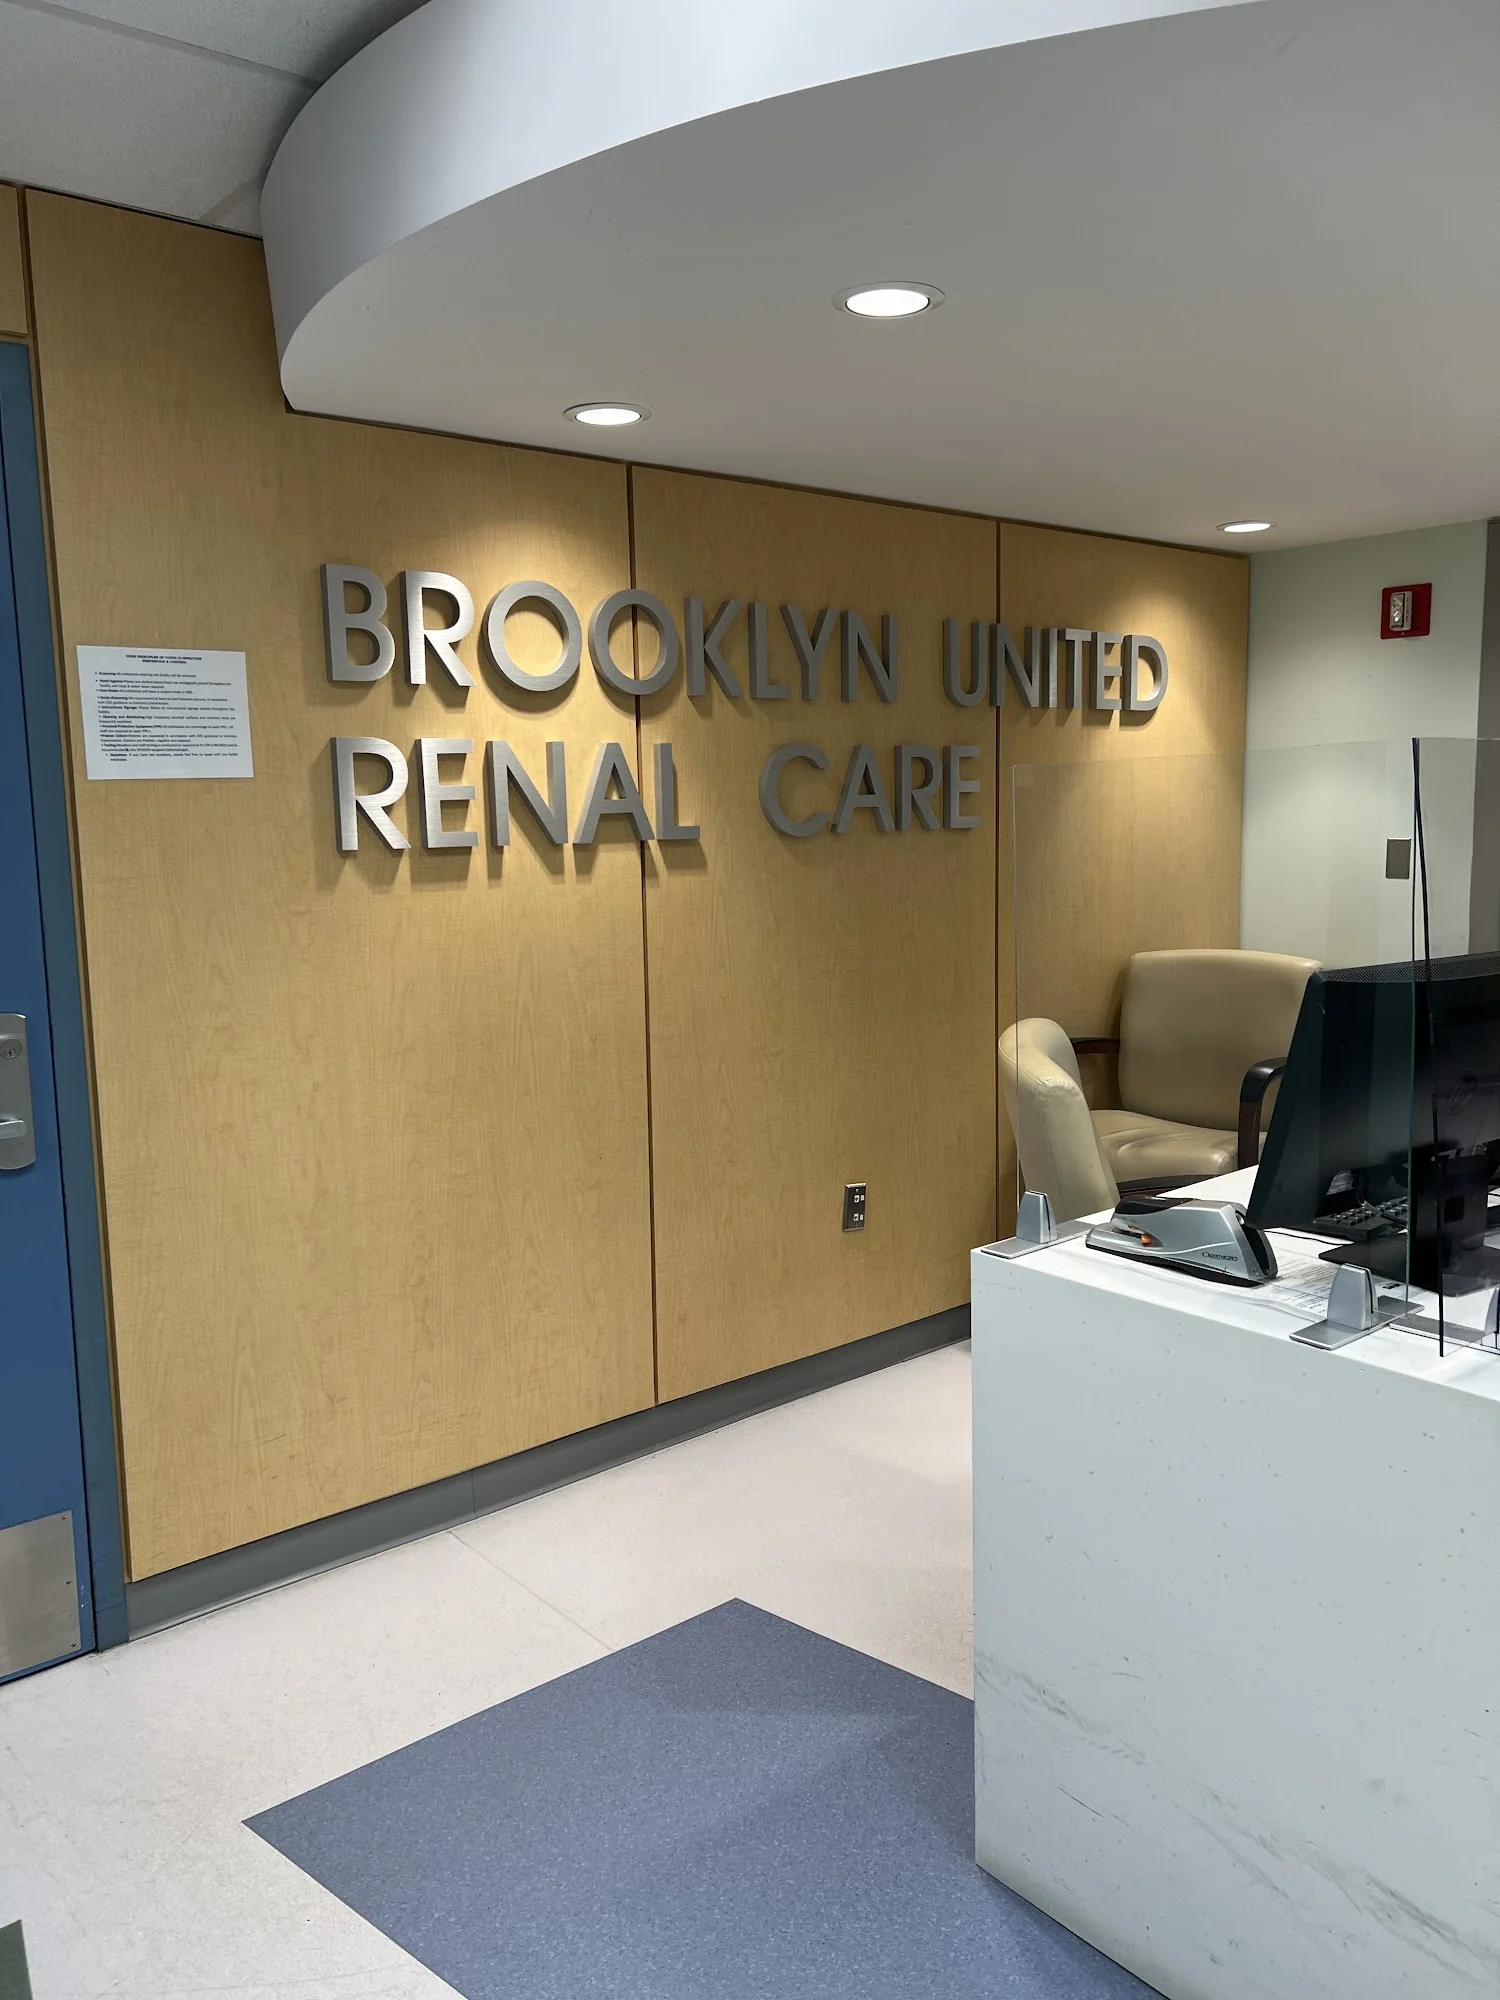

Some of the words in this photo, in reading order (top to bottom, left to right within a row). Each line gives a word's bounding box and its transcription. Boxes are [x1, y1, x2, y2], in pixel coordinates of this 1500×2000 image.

[320, 563, 896, 702] BROOKLYN
[942, 619, 1169, 711] UNITED
[331, 737, 699, 851] RENAL
[758, 743, 980, 838] CARE
